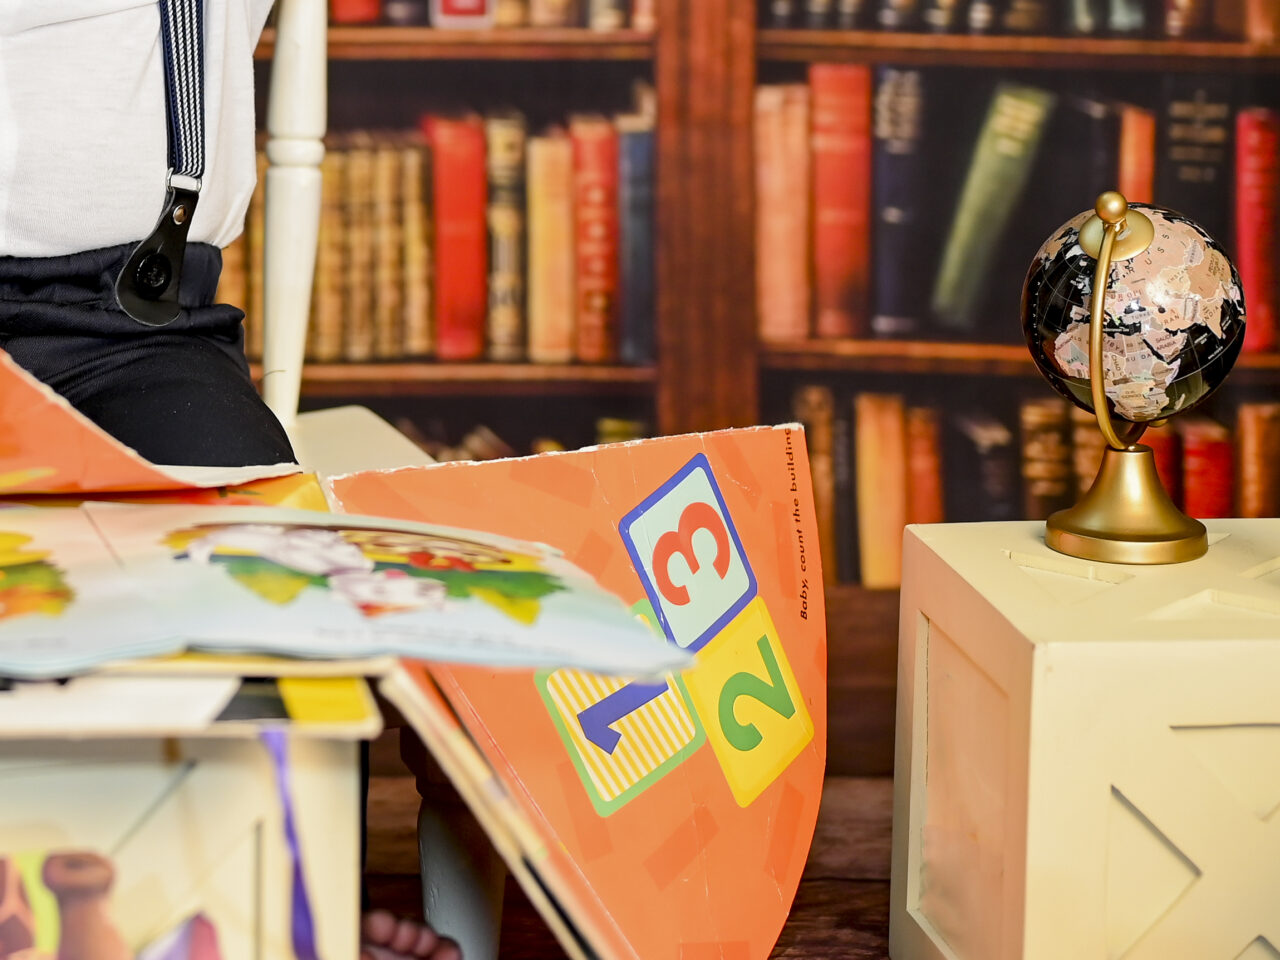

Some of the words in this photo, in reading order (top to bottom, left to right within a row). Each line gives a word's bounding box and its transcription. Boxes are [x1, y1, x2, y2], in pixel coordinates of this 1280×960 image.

[792, 500, 801, 523] the
[651, 501, 731, 606] 3
[796, 528, 806, 572] count
[800, 578, 809, 621] Baby,
[576, 674, 669, 756] 1
[717, 633, 796, 752] 2
